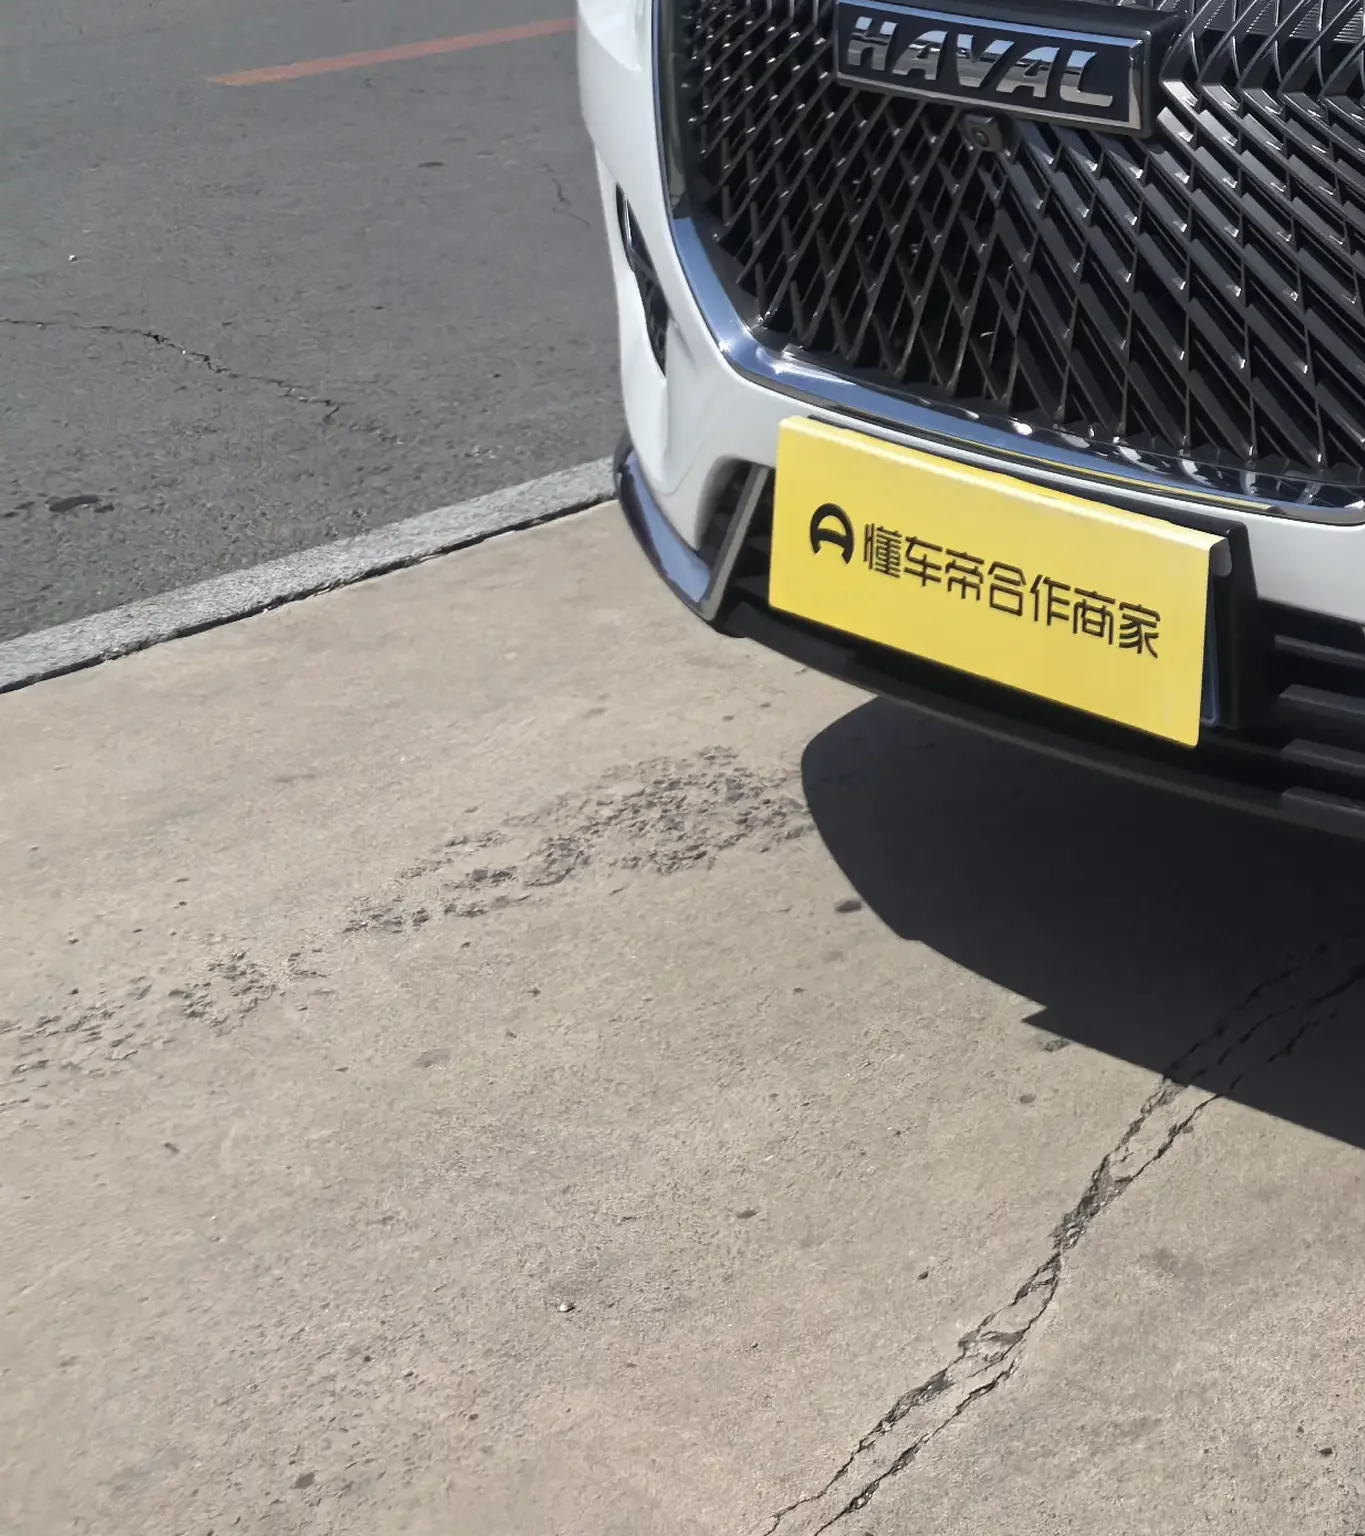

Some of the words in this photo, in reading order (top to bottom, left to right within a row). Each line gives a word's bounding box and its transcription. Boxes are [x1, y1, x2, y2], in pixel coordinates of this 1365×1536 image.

[847, 16, 1113, 107] HAVAL
[863, 522, 1161, 659] 懂车帝合作商家
